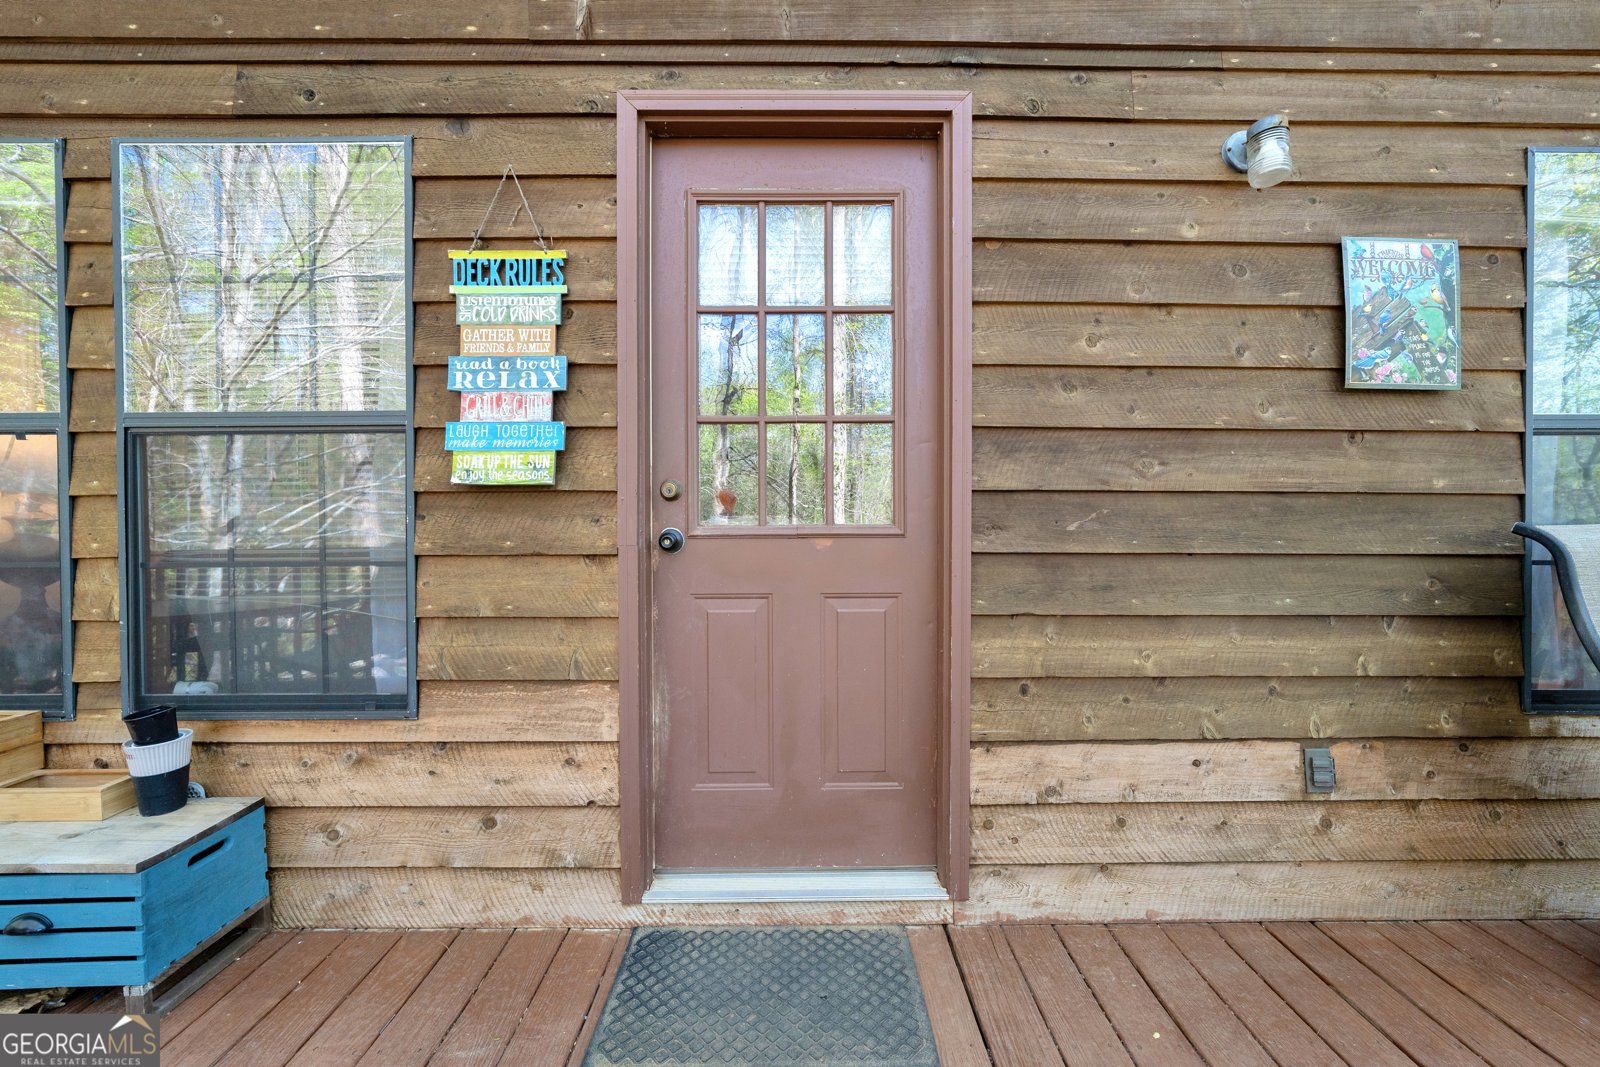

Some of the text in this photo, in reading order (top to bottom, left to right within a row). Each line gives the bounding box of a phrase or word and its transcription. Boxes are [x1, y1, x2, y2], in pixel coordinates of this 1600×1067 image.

[453, 258, 565, 286] DECK RULES
[1350, 259, 1436, 280] WELCOME
[472, 305, 507, 322] COLD
[509, 305, 557, 322] DRINKS
[462, 328, 552, 342] GATHER WITH
[463, 342, 551, 353] FRIENDS & FAMILY
[454, 356, 561, 371] read a book
[500, 395, 512, 418] &
[513, 394, 545, 418] CHILL
[448, 436, 559, 448] make memories
[456, 454, 551, 469] SOAK UP THE SUN
[455, 469, 485, 483] enjoy
[487, 468, 503, 480] the
